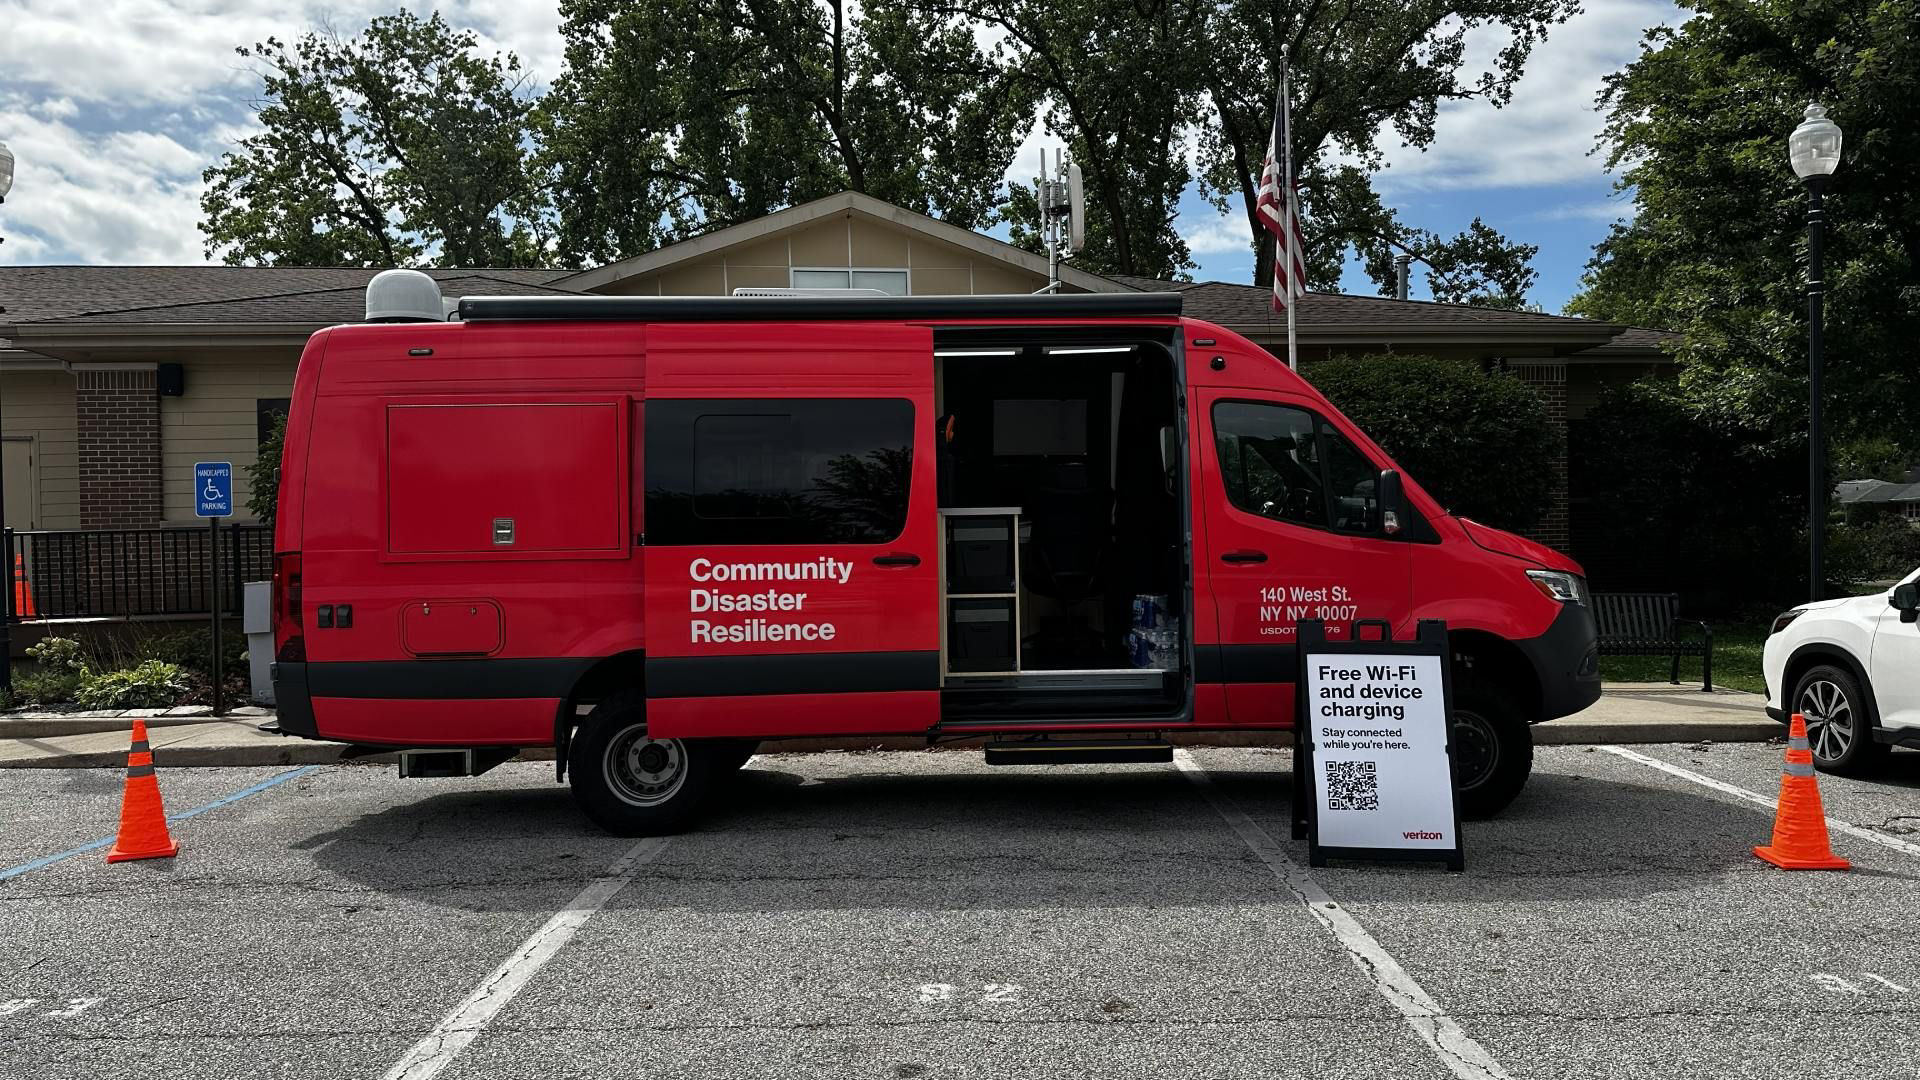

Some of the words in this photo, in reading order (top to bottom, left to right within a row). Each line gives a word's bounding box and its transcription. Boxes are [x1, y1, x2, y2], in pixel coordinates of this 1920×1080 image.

[197, 469, 229, 477] HANDICAPPED
[202, 502, 225, 510] PARKING
[689, 556, 854, 584] Community
[690, 588, 807, 613] Disaster
[1260, 586, 1286, 603] 140
[1289, 586, 1328, 602] West
[1331, 585, 1352, 602] St.
[1260, 605, 1282, 622] NY
[1286, 605, 1309, 621] NY
[1314, 605, 1358, 621] 10007
[691, 618, 836, 643] Resilience
[1260, 626, 1297, 635] USDOT
[1318, 665, 1362, 681] Free
[1365, 665, 1416, 681] Wi-Fi
[1319, 683, 1355, 699] and
[1359, 683, 1423, 699] device
[1321, 701, 1405, 721] charging
[1322, 727, 1346, 739] Stay
[1347, 727, 1402, 738] connected
[1323, 739, 1350, 749] while
[1351, 739, 1383, 750] you're
[1384, 740, 1411, 750] here.
[1402, 829, 1443, 840] verizon
